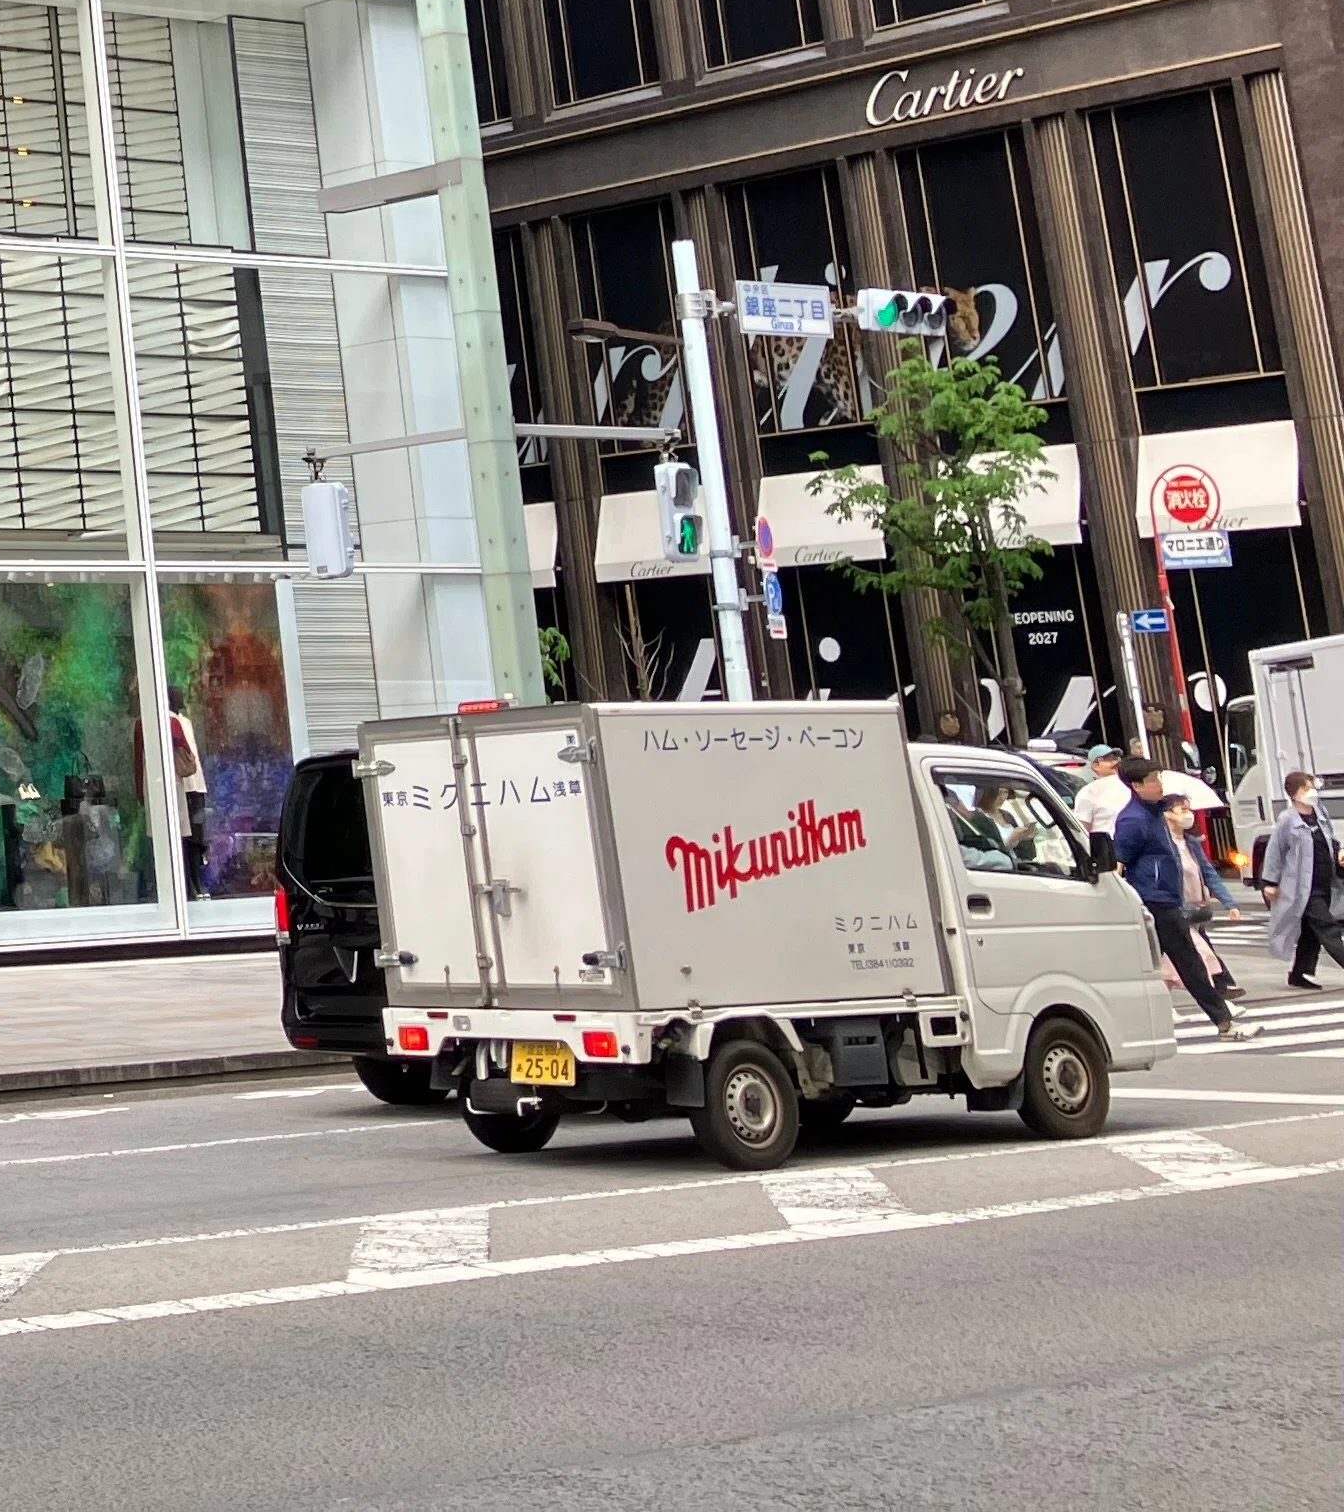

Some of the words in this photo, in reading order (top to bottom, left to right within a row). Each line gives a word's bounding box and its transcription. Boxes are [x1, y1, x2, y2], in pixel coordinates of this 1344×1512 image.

[865, 65, 1027, 128] Cartier
[745, 296, 825, 320] 銀座二丁目
[771, 317, 794, 331] Ginza
[797, 320, 803, 331] 2
[1166, 487, 1208, 510] 消火栓
[1165, 536, 1225, 553] マロニエ通り
[794, 545, 844, 566] Cartier
[630, 561, 674, 579] Cartier
[1014, 609, 1075, 626] EOPENING
[1028, 631, 1058, 646] 2027
[834, 913, 918, 933] ミクニハム
[525, 1057, 569, 1081] 25-04
